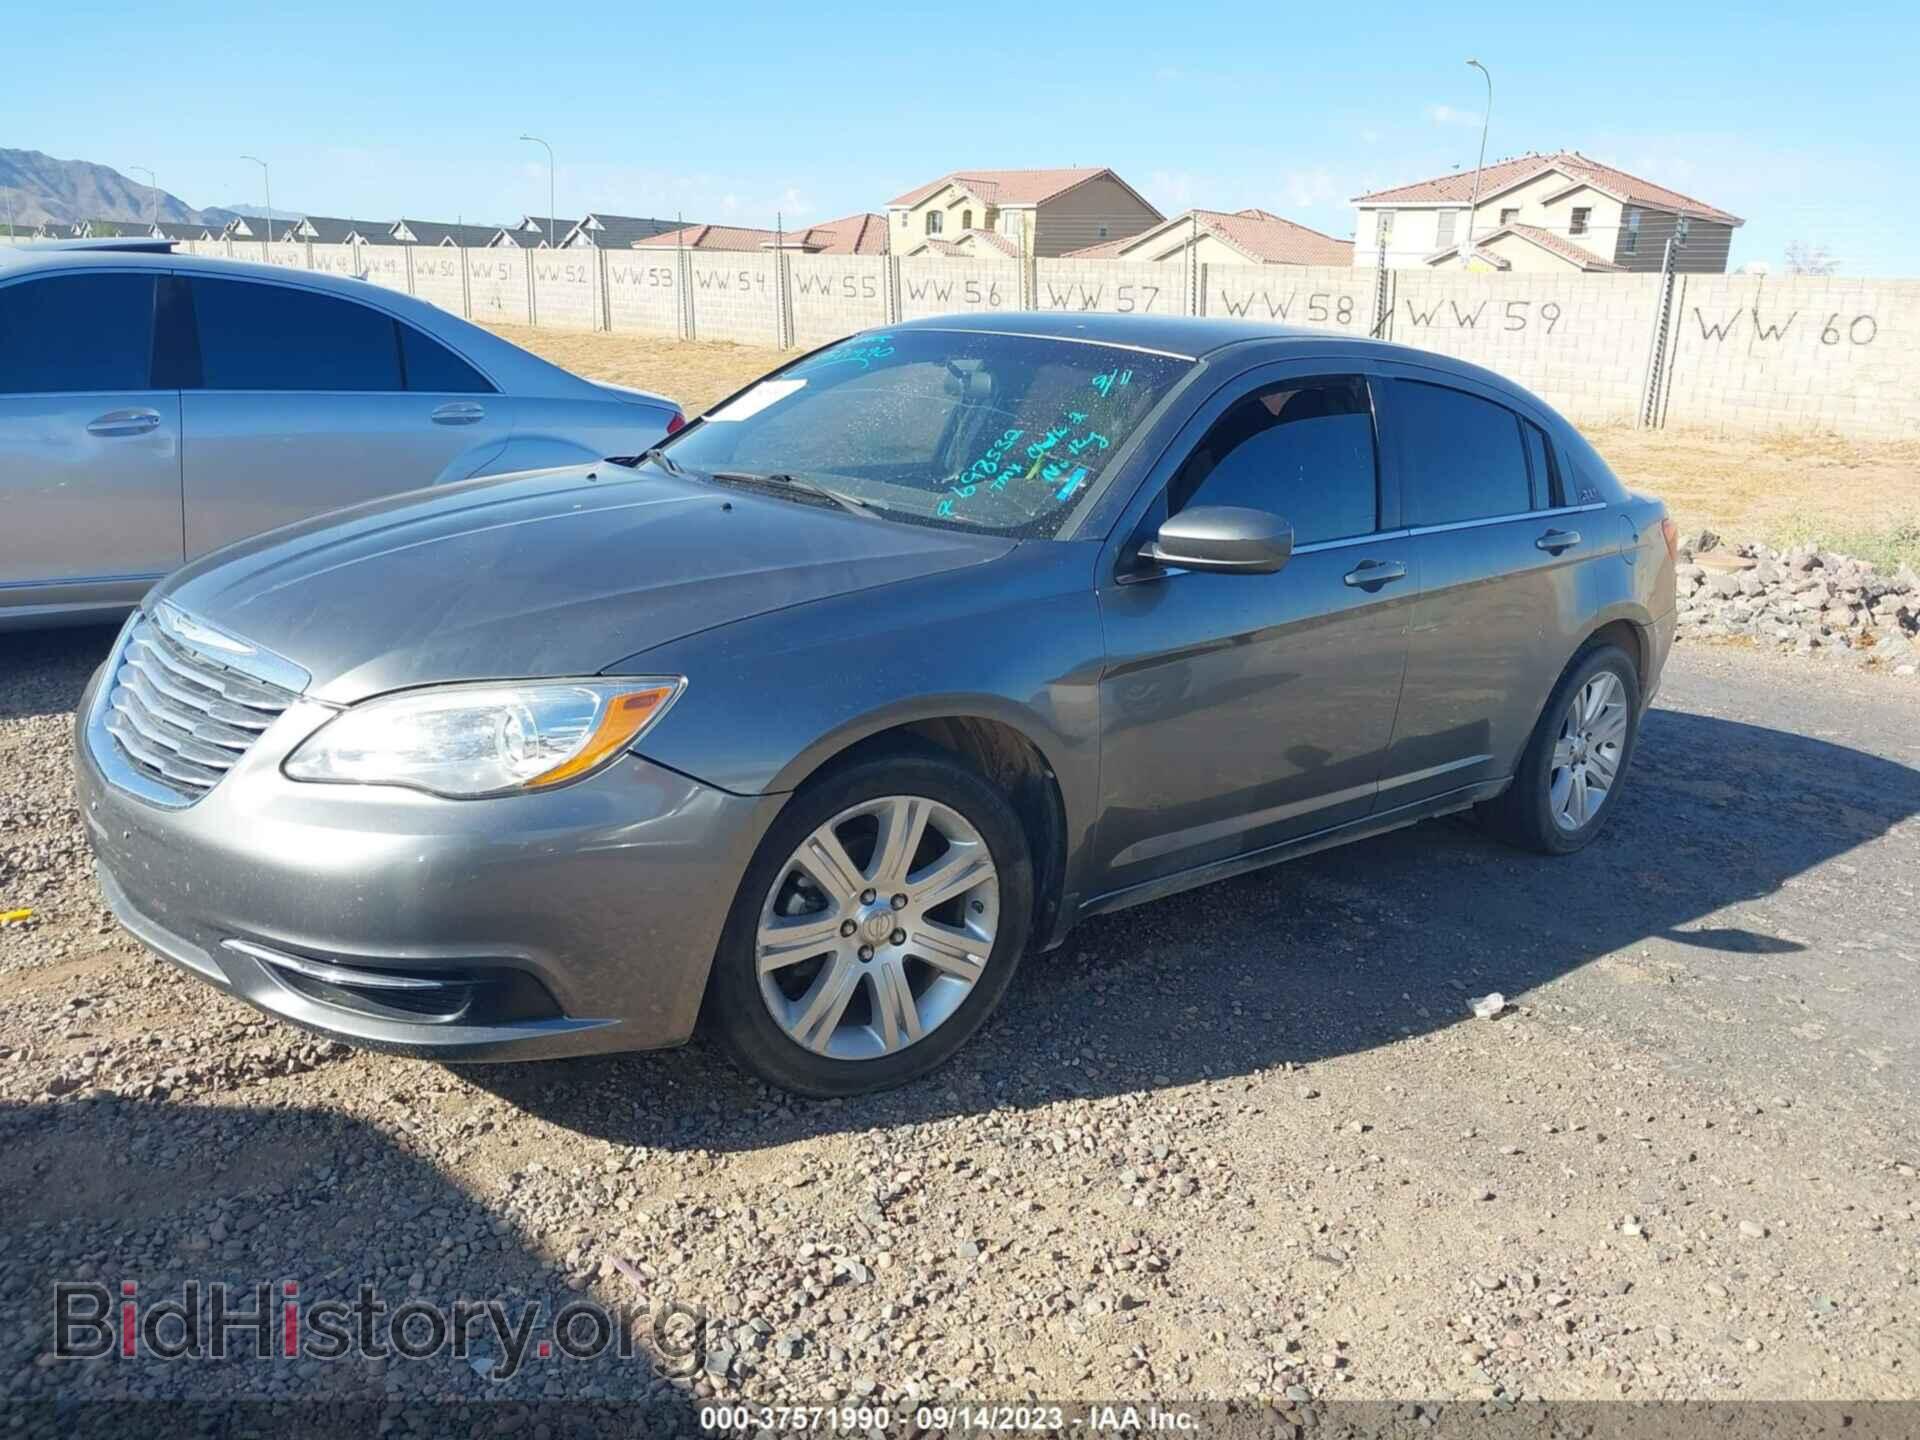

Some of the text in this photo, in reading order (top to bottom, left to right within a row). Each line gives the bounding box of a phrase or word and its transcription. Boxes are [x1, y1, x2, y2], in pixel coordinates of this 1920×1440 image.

[416, 259, 455, 277] WW 50
[471, 263, 512, 281] WW 51
[536, 264, 587, 284] WW 52
[611, 267, 674, 288] WW 53
[696, 270, 766, 292] WW 54
[796, 273, 876, 298] WW 55
[907, 280, 1001, 307] WW 56
[1048, 283, 1160, 313] WW 57
[1222, 289, 1354, 325] WW 58
[1406, 299, 1561, 335] WW 59
[1694, 307, 1878, 346] WW 60
